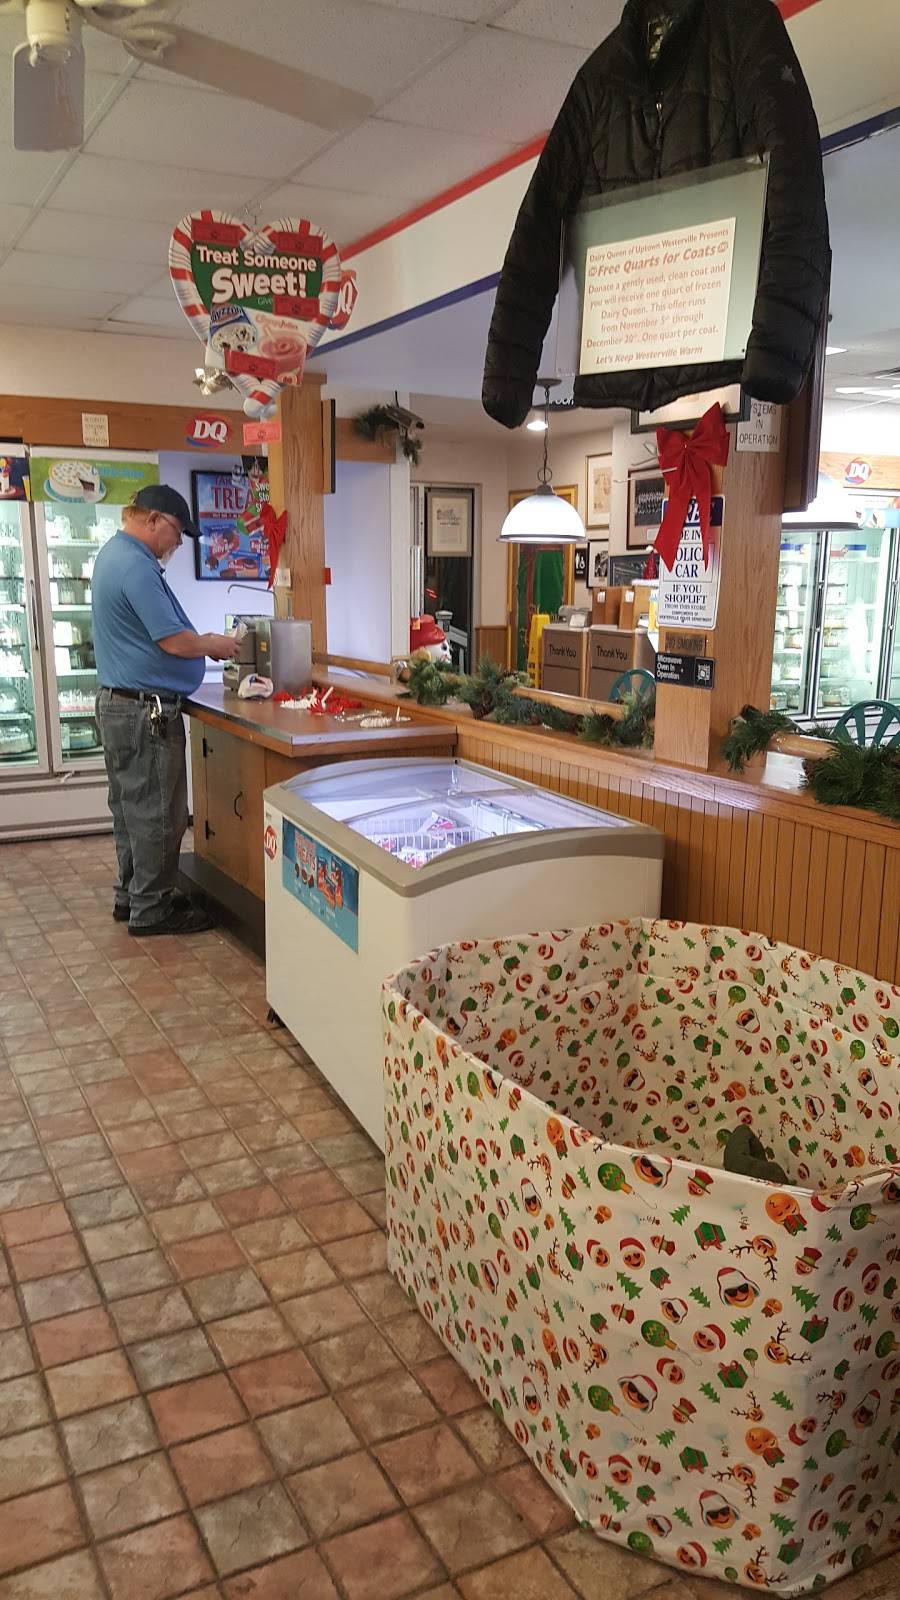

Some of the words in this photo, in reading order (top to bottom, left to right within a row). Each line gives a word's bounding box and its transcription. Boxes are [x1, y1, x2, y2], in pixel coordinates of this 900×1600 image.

[590, 252, 606, 262] Dairy
[606, 250, 627, 261] Queen
[628, 244, 635, 255] of
[635, 242, 660, 254] Uptown
[662, 233, 697, 248] Westerville
[700, 229, 729, 241] Presents
[196, 245, 239, 266] Treat
[244, 252, 317, 272] Someone
[597, 264, 620, 277] Free
[623, 256, 660, 274] Quarts
[662, 252, 680, 265] for
[683, 245, 716, 261] Coats
[211, 268, 307, 303] Sweet!
[588, 283, 614, 295] Donate
[622, 277, 644, 291] gently
[646, 271, 666, 284] used,
[668, 271, 689, 281] clean
[690, 266, 708, 277] coat
[709, 261, 726, 275] and
[590, 299, 603, 310] you
[604, 294, 617, 305] will
[617, 289, 644, 303] receive
[646, 288, 660, 299] one
[662, 285, 684, 299] quart
[685, 280, 693, 292] of
[694, 280, 721, 292] frozen
[601, 310, 620, 320] Dairy
[622, 306, 649, 317] Queen.
[650, 302, 666, 312] This
[668, 298, 687, 309] offer
[688, 298, 706, 308] runs
[601, 323, 618, 334] from
[619, 318, 658, 331] November
[672, 311, 704, 324] through
[586, 336, 622, 348] December
[641, 331, 659, 342] One
[660, 329, 681, 341] quart
[683, 328, 698, 340] per
[698, 325, 719, 335] coat.
[596, 354, 613, 365] Let's
[614, 353, 634, 364] Keep
[636, 347, 678, 361] Westerville
[679, 346, 703, 356] Warm
[192, 419, 228, 443] DQ
[755, 418, 764, 429] IN
[739, 432, 778, 446] OPERATION
[848, 462, 871, 480] DQ
[255, 482, 269, 492] Swe
[211, 487, 253, 511] TREA
[676, 547, 704, 562] OLIC
[675, 563, 698, 578] CAR
[672, 584, 681, 593] IF
[683, 584, 702, 594] YOU
[664, 594, 708, 605] SHOPLIFT
[549, 644, 566, 657] Thank
[566, 647, 577, 658] You
[596, 645, 614, 658] Thank
[615, 648, 628, 660] You
[657, 654, 682, 664] Microwave
[656, 662, 670, 670] Oven
[656, 670, 680, 680] Operation
